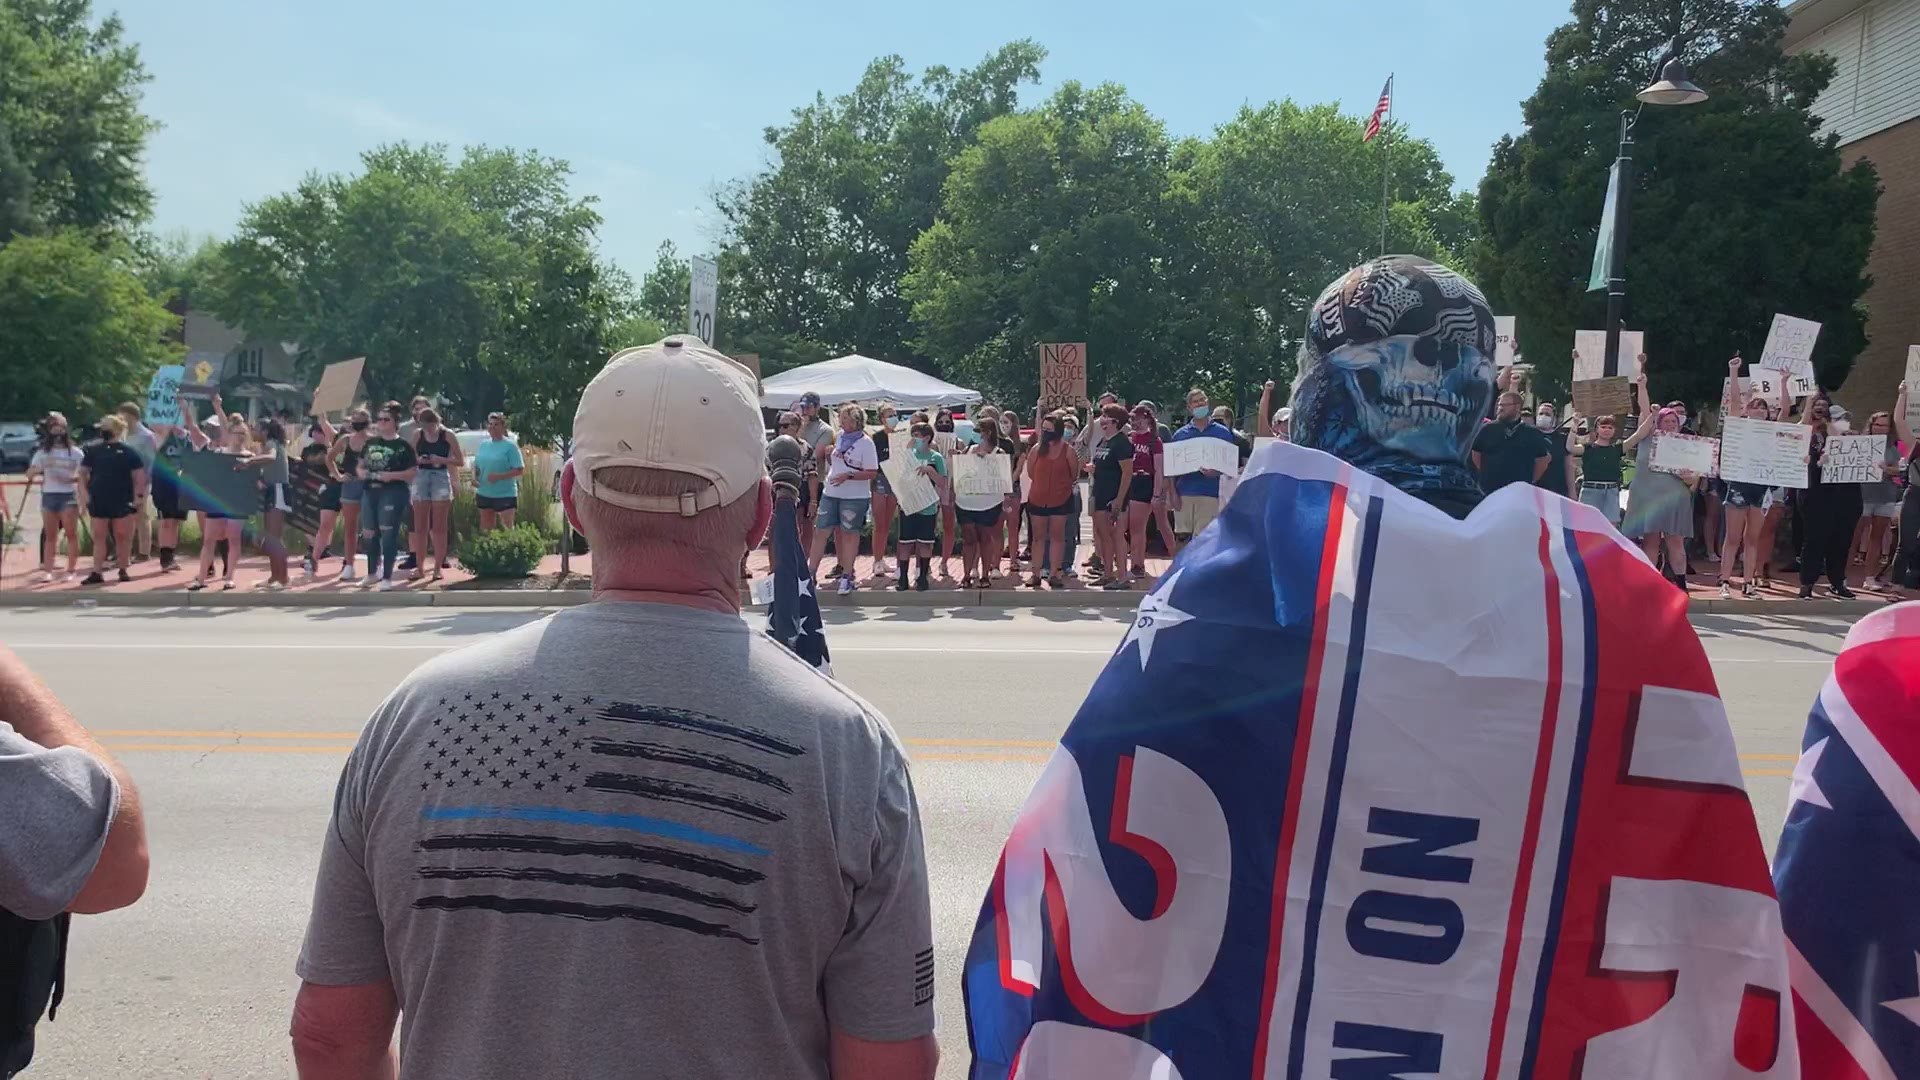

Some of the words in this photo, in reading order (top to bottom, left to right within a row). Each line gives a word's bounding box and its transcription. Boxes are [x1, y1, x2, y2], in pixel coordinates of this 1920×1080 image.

[694, 309, 712, 345] 30
[1042, 364, 1084, 380] JUSTICE
[1047, 395, 1081, 408] PEACE
[1830, 438, 1883, 456] BLACK
[1833, 455, 1873, 466] LIVES
[1823, 465, 1880, 482] MATTER
[1345, 806, 1481, 965] NO
